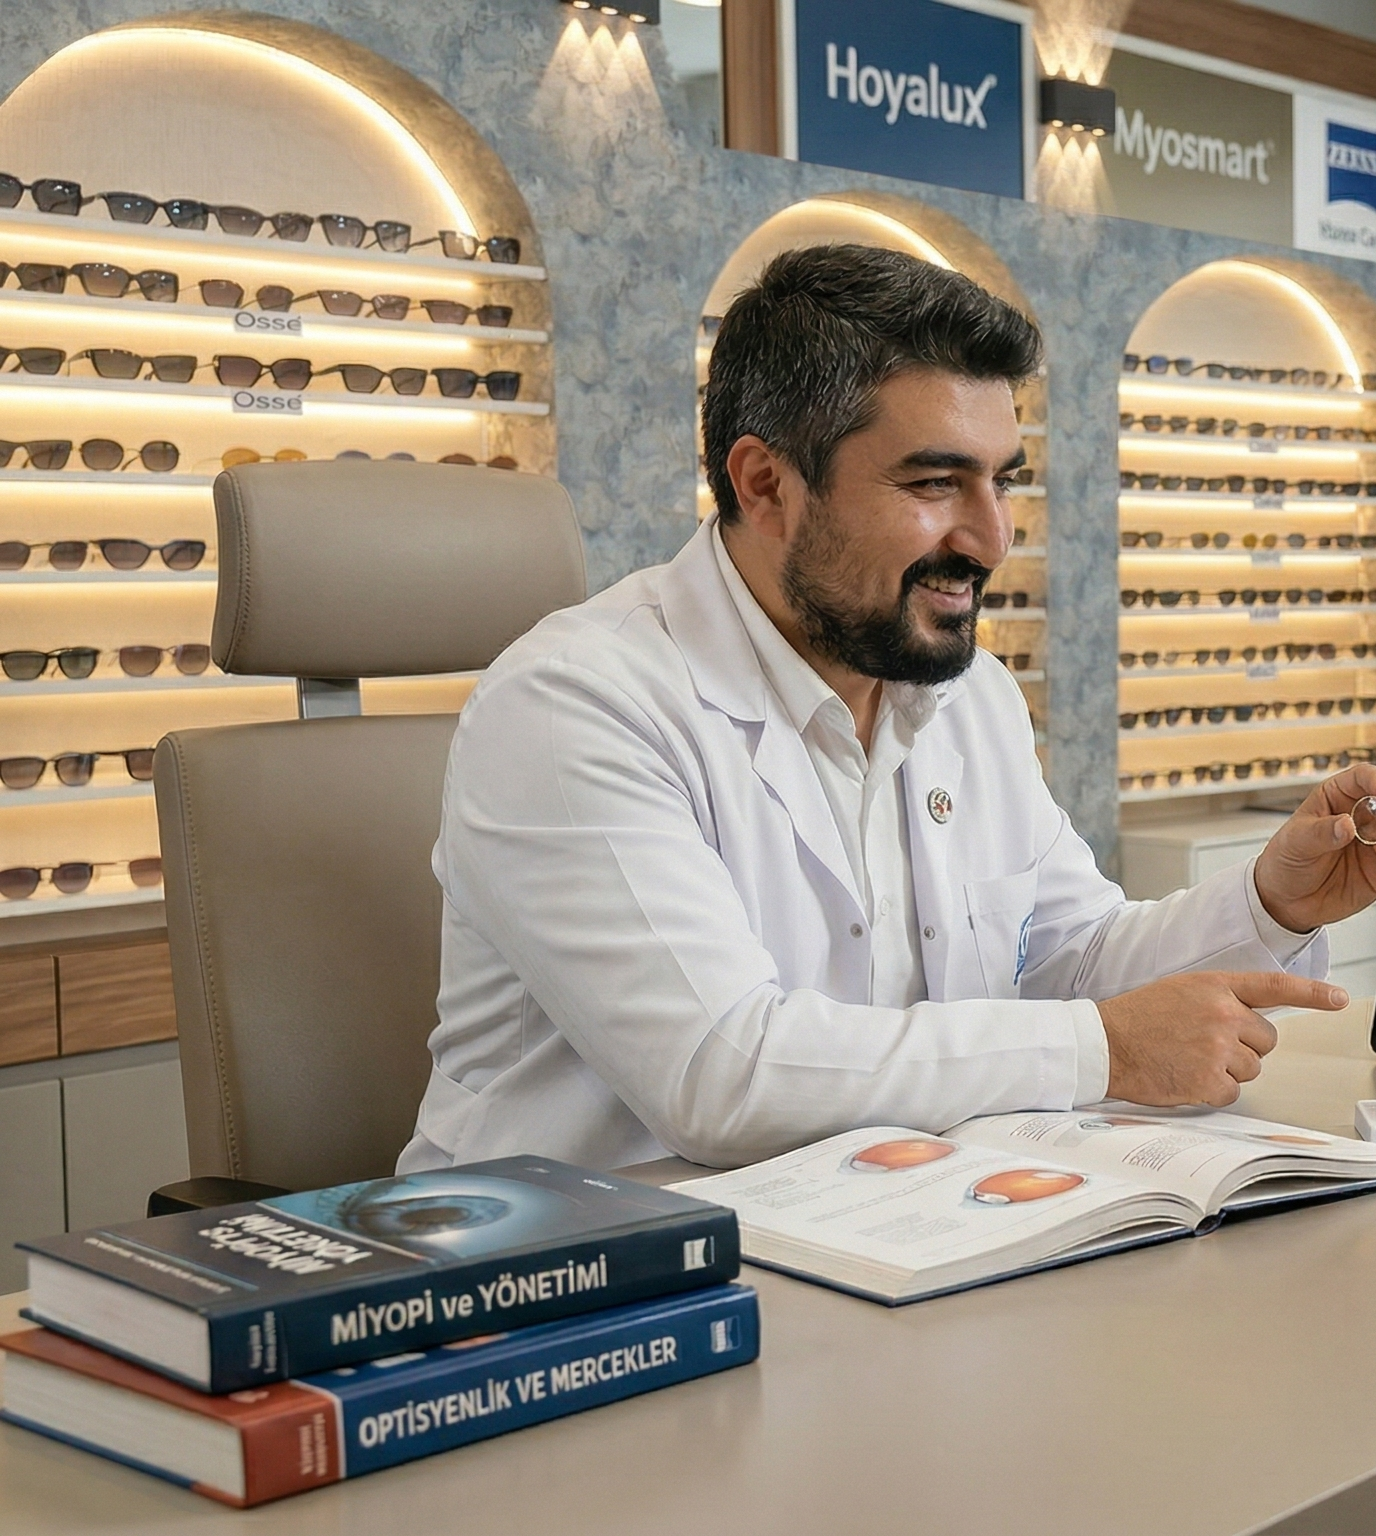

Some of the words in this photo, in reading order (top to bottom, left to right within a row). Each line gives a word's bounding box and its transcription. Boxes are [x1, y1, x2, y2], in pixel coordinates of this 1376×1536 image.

[235, 311, 301, 331] Ossé
[234, 391, 302, 410] Ossé
[331, 1289, 434, 1346] MİYOPİ
[441, 1293, 474, 1320] ve
[477, 1253, 608, 1312] YÖNETİMİ
[359, 1377, 512, 1448] OPTİSYENLİK
[515, 1371, 546, 1404] VE
[551, 1336, 678, 1395] MERCEKLER
